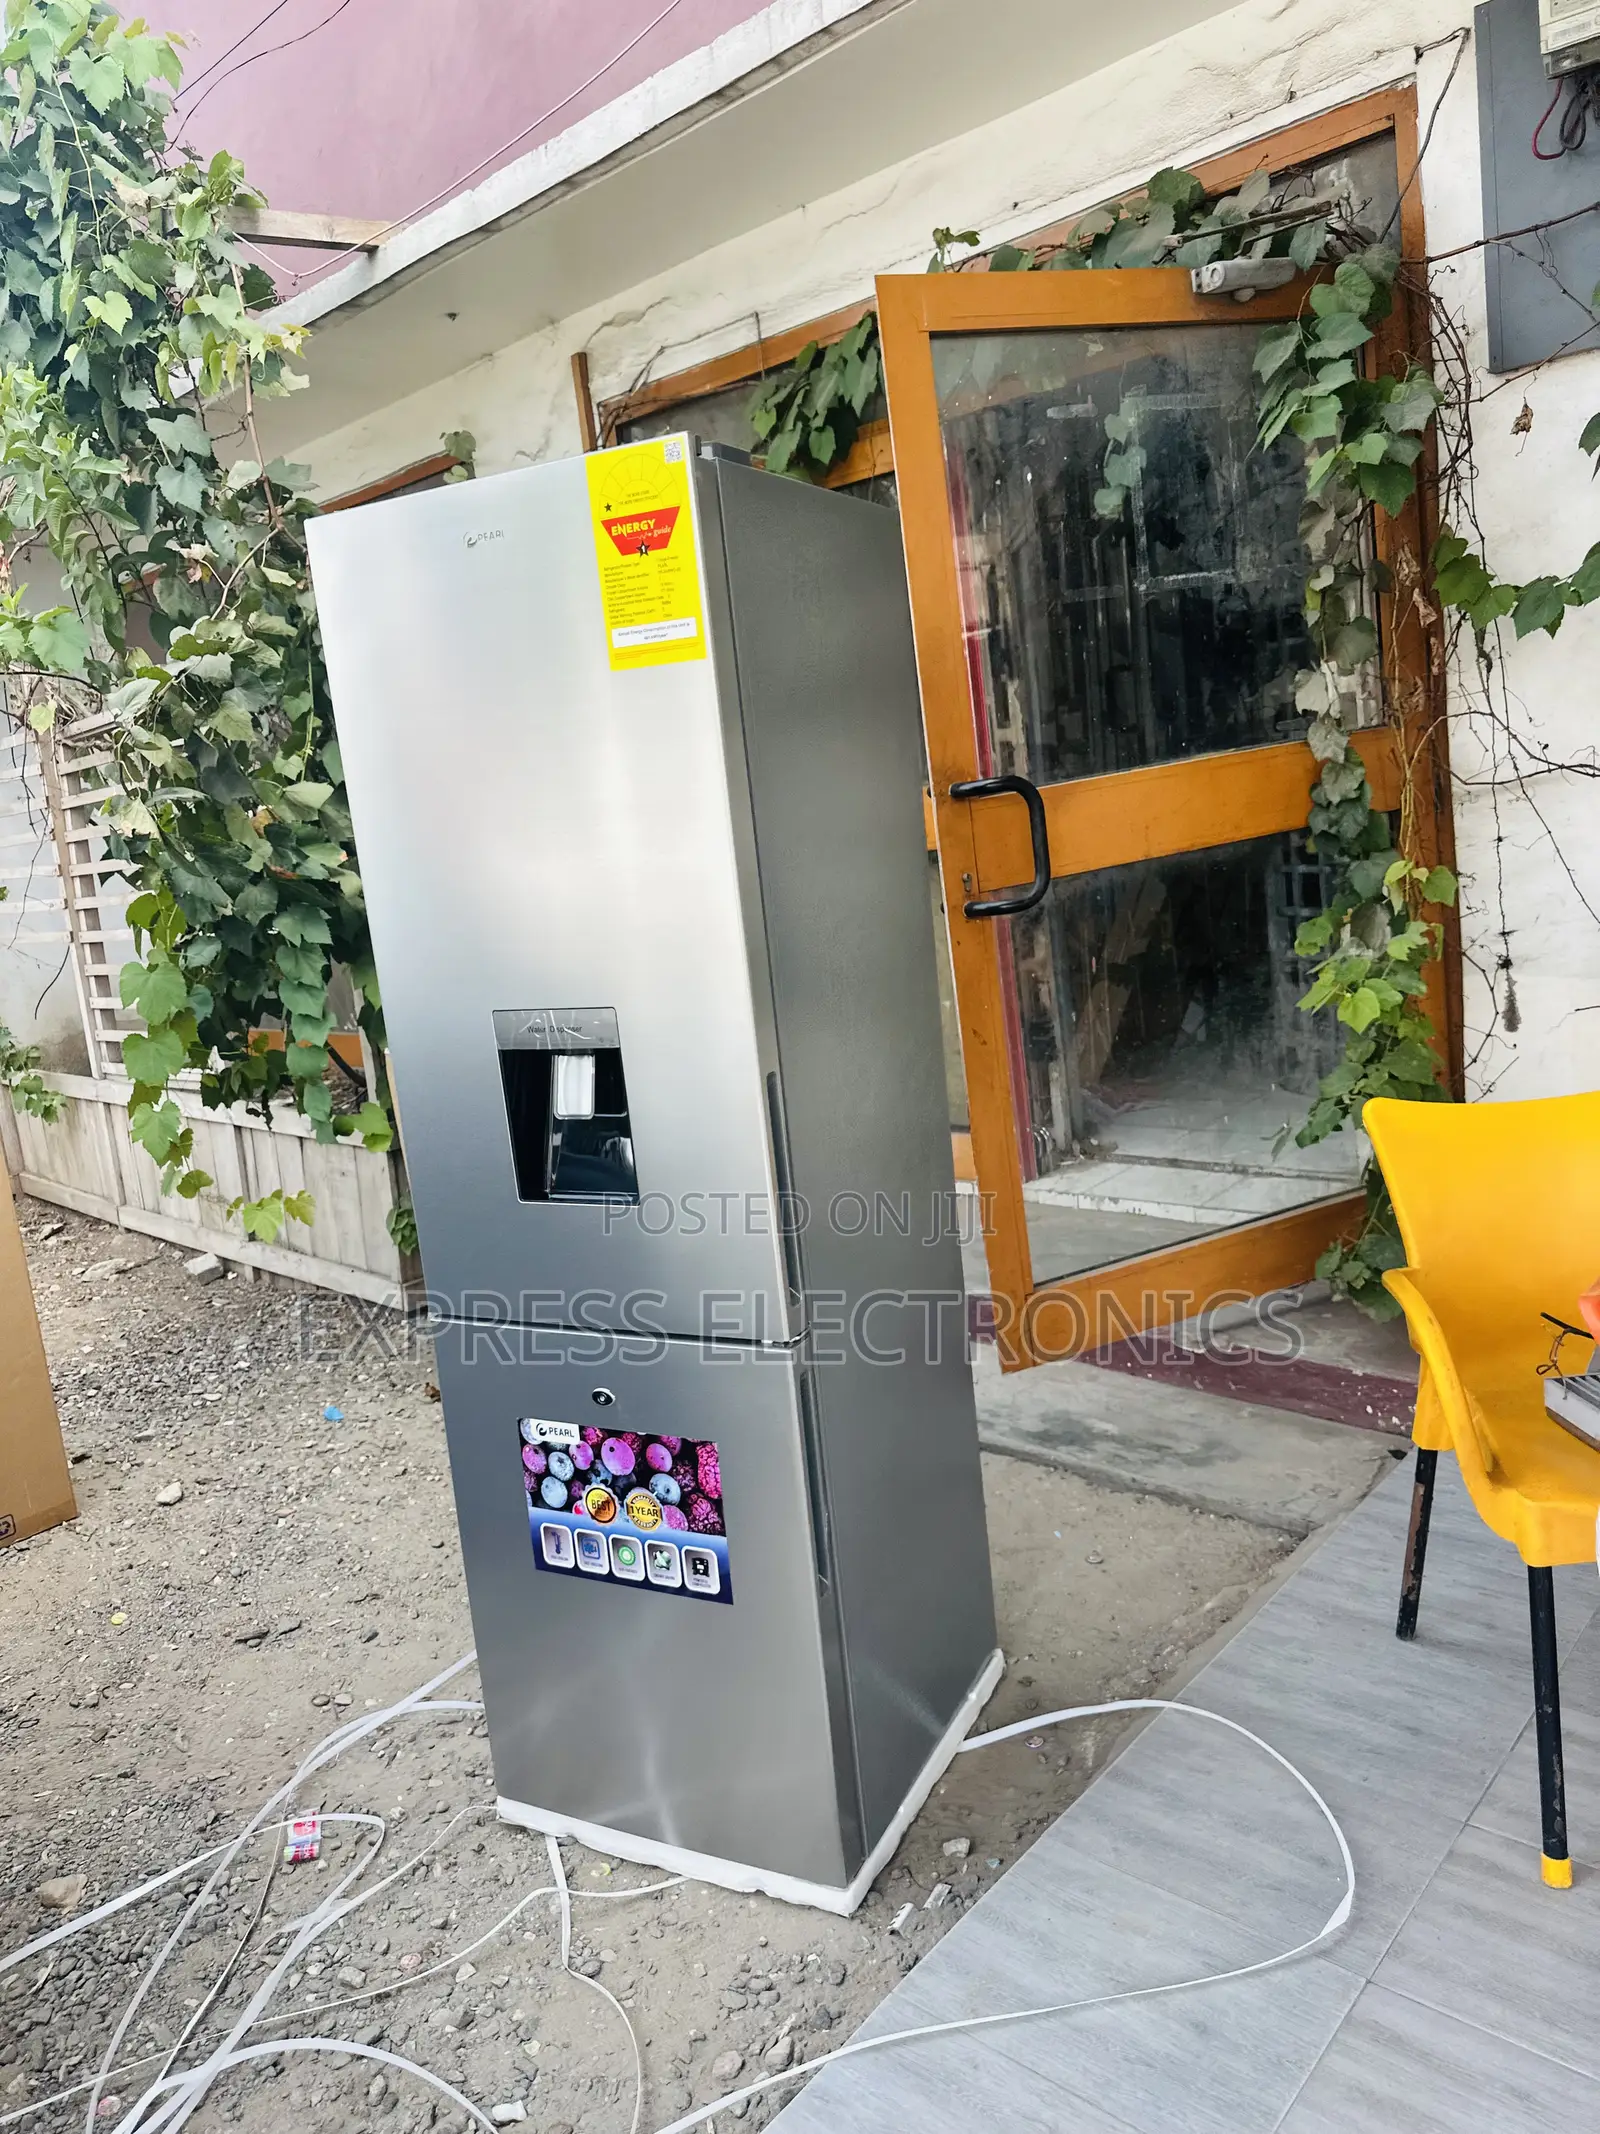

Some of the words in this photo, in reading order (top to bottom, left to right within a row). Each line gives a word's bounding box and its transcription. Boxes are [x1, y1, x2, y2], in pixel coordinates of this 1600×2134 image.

[611, 519, 656, 537] ENERGY
[653, 525, 672, 537] guide
[641, 545, 646, 553] 1
[548, 1427, 575, 1438] PEARL
[592, 1499, 611, 1512] BEST
